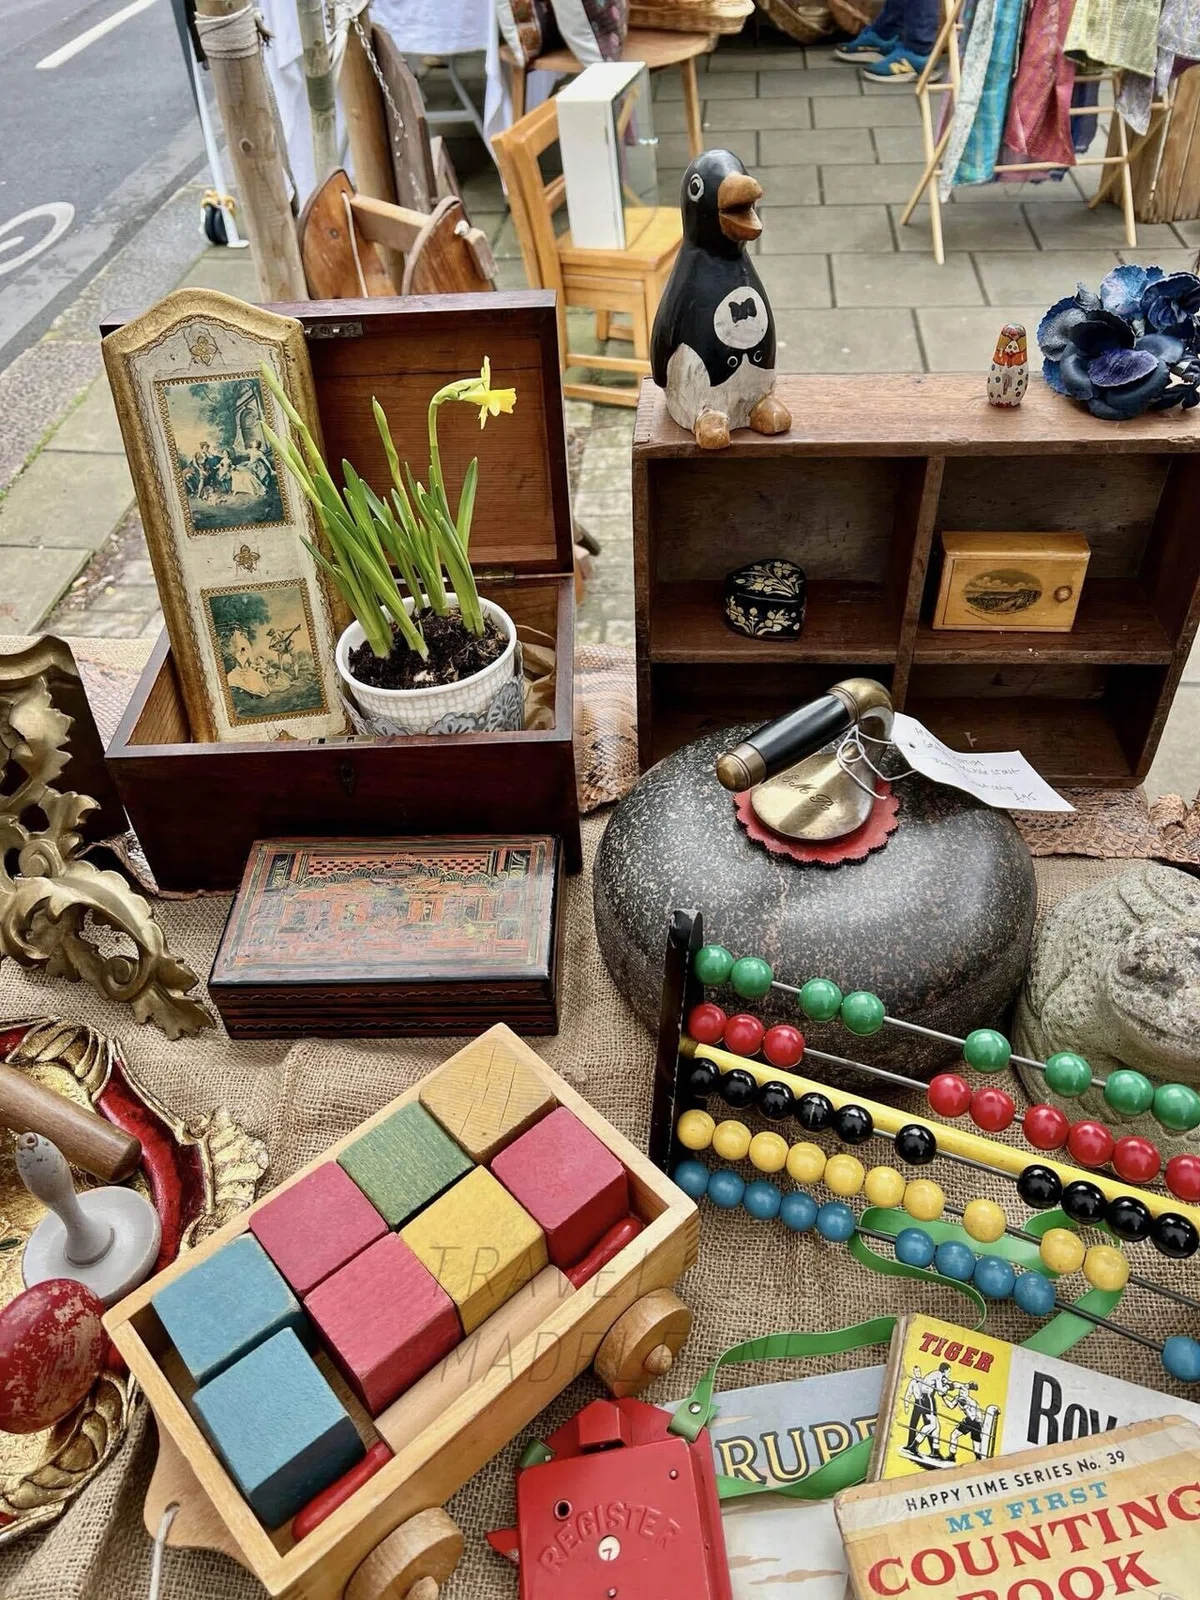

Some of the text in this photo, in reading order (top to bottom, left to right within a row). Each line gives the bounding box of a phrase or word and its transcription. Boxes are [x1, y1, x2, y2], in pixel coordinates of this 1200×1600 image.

[918, 1331, 995, 1373] TIGER
[905, 1450, 1126, 1512] HAPPY TIME SERIES No. 39
[945, 1480, 1108, 1534] MY FIRST
[538, 1500, 681, 1575] REGISTER
[867, 1480, 1200, 1597] COUNTING
[956, 1549, 1162, 1600] OOK
